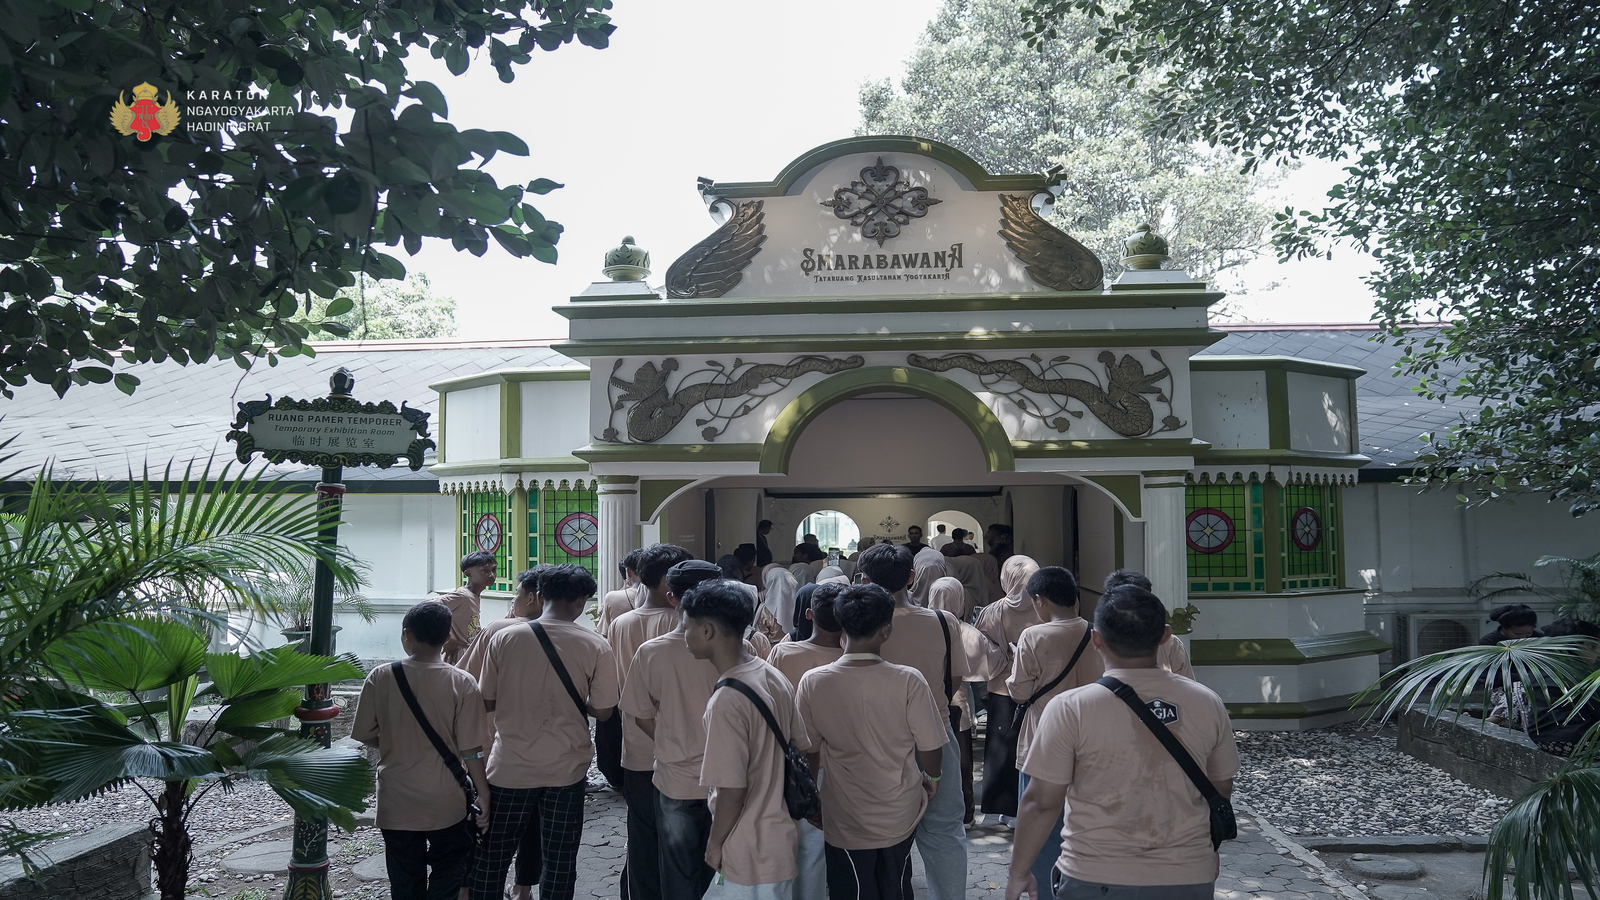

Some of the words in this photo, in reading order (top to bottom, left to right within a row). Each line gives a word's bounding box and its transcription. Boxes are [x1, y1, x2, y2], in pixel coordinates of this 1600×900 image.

[800, 243, 963, 276] SMARABAWANA
[268, 414, 304, 422] RUANG
[307, 415, 344, 424] PAMER
[347, 416, 402, 426] TEMPORER
[275, 425, 321, 434] Temporary
[324, 426, 367, 435] Exhibition
[370, 428, 395, 436] Room
[293, 436, 375, 448] 临时展览室
